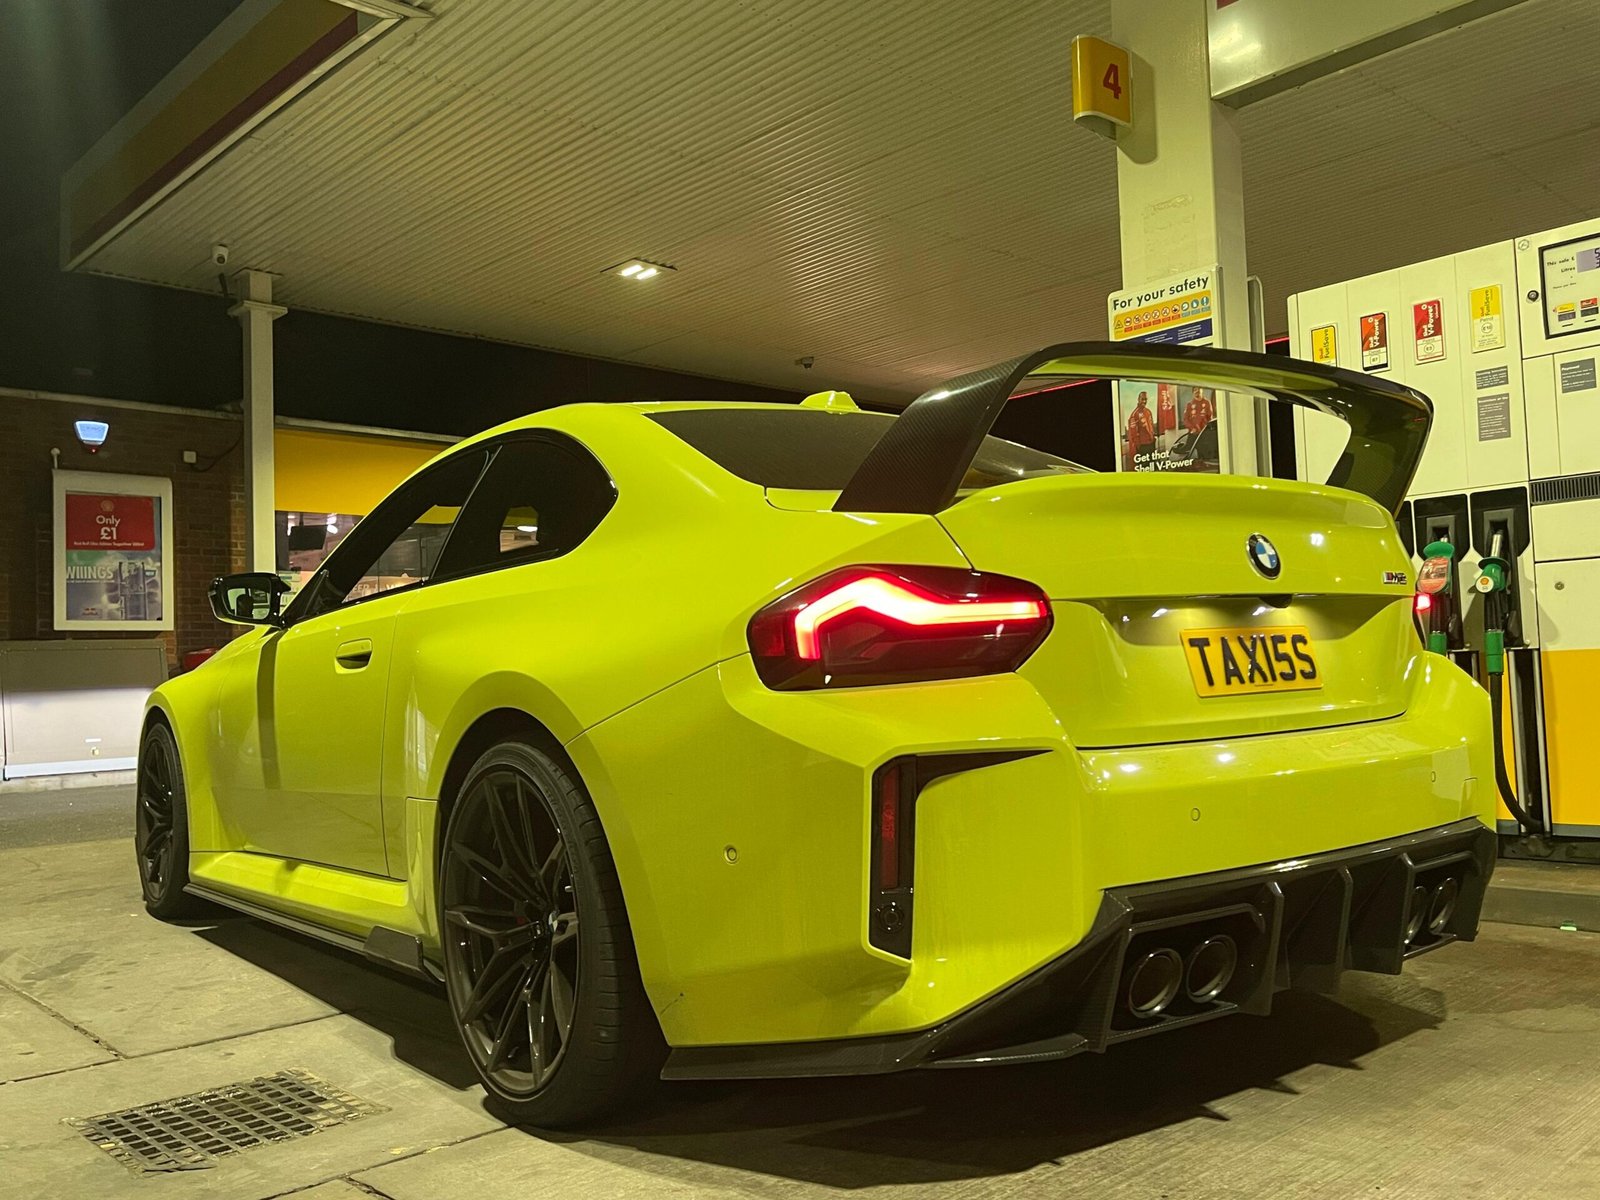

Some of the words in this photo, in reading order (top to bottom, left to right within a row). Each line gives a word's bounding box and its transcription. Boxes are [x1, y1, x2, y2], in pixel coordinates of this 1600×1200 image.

[1102, 63, 1122, 100] 4
[1113, 296, 1133, 310] For
[1136, 289, 1165, 307] your
[1169, 276, 1209, 295] safety
[1133, 452, 1151, 464] Get
[1152, 449, 1170, 461] that
[1134, 460, 1155, 472] Shell
[1156, 457, 1193, 471] V-Power
[95, 515, 121, 527] Only
[100, 526, 117, 540] £1
